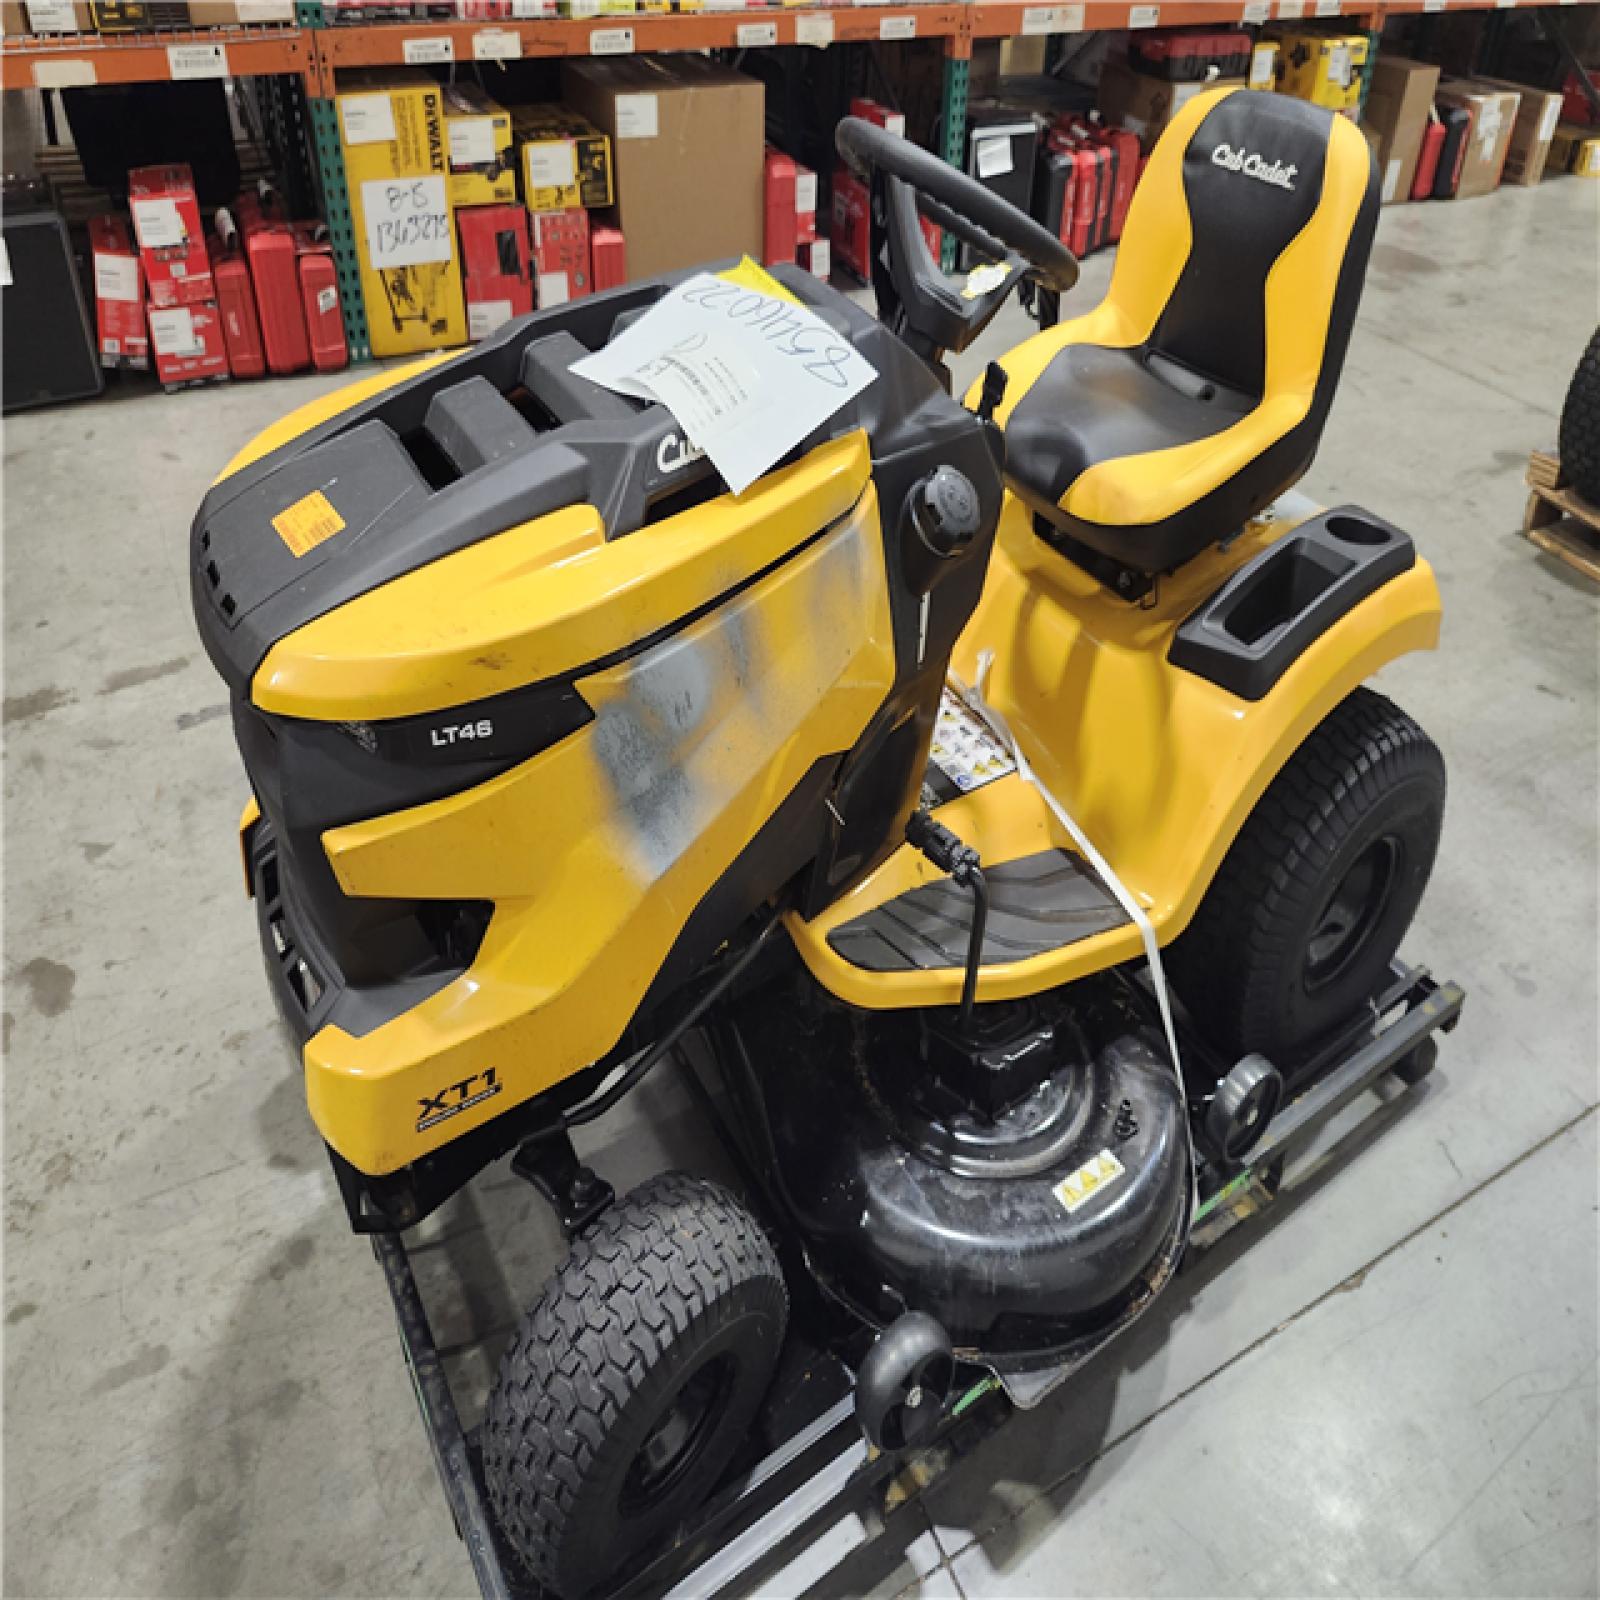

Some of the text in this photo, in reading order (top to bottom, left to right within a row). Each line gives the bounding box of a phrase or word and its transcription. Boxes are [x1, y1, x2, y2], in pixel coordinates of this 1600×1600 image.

[1212, 144, 1297, 190] Cub Cadet
[416, 1067, 496, 1121] XT1
